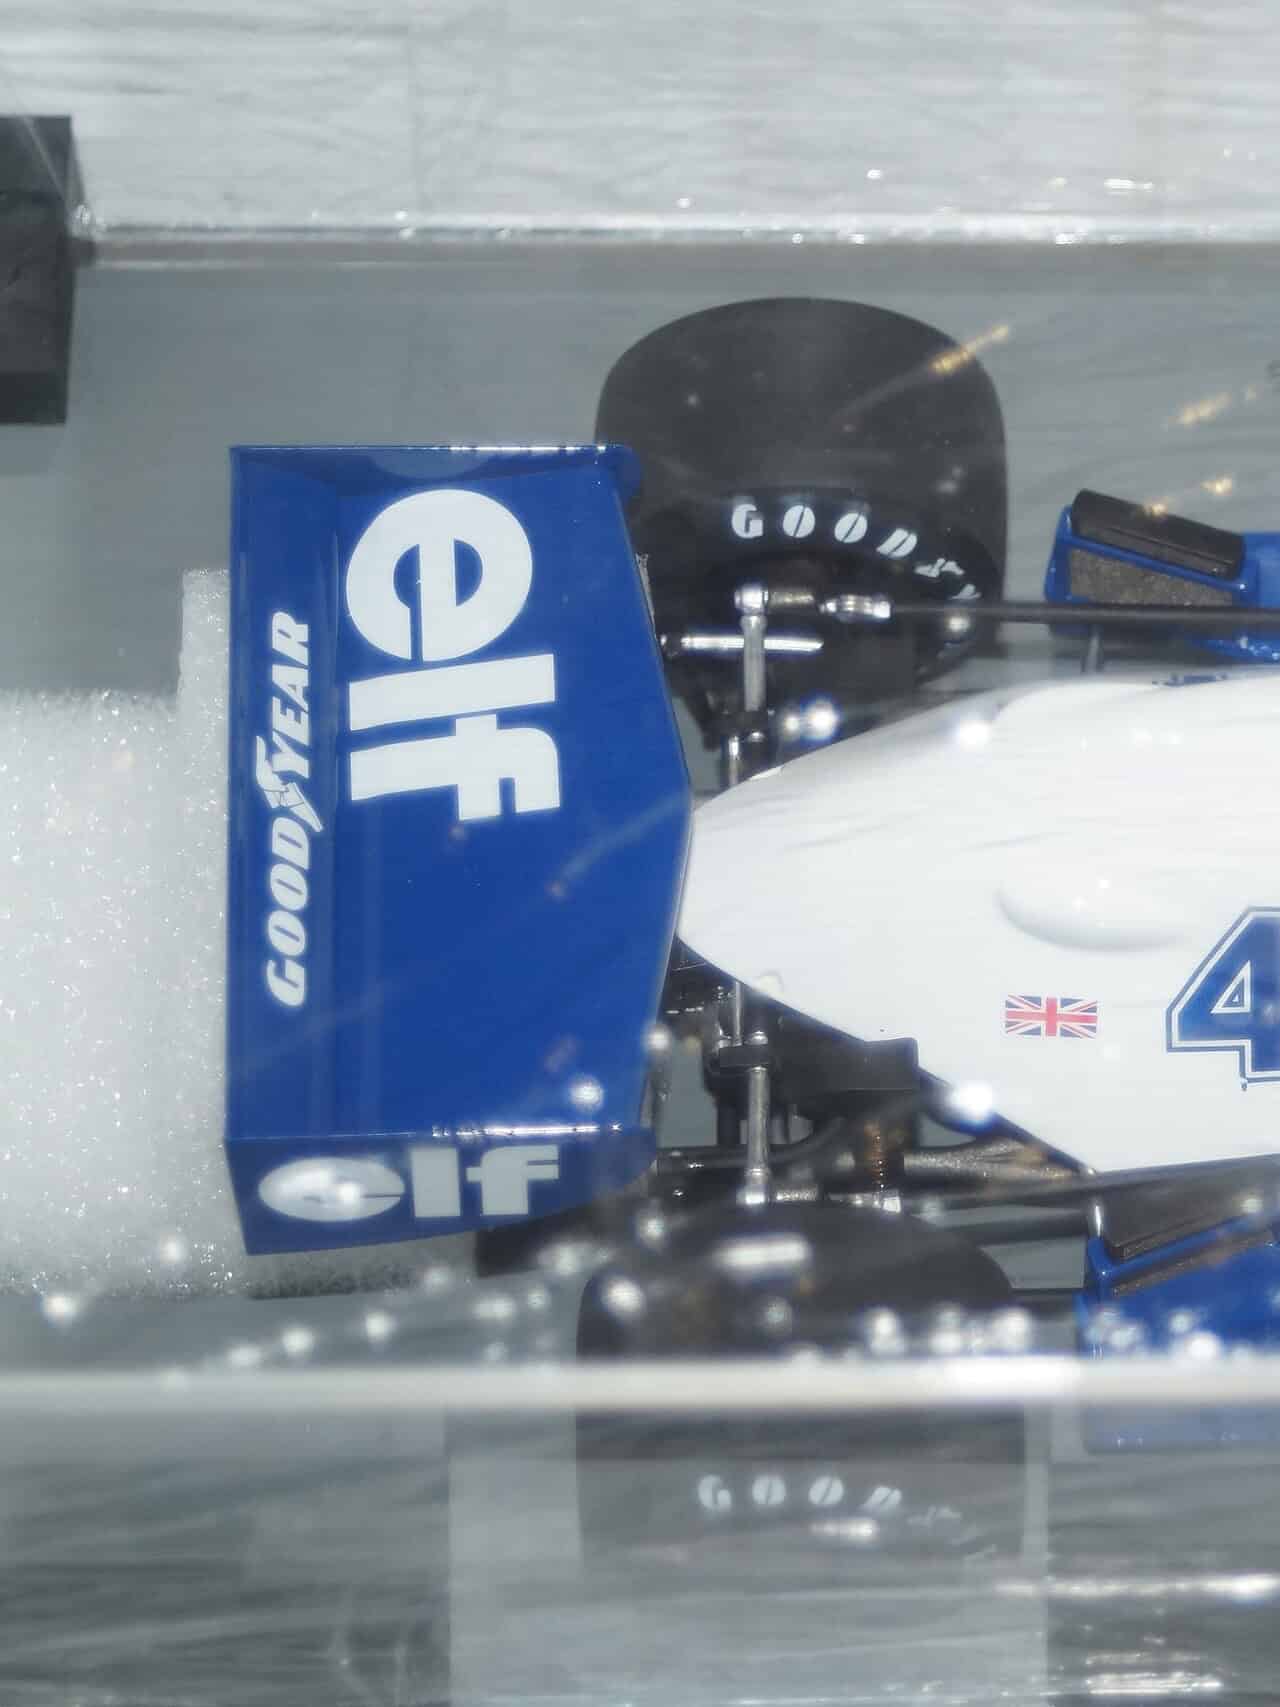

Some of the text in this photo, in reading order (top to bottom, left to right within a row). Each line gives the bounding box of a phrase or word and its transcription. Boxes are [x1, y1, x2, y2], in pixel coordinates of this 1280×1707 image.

[256, 611, 324, 1008] GOODYEAR
[346, 489, 560, 821] elf
[258, 1145, 560, 1221] elf
